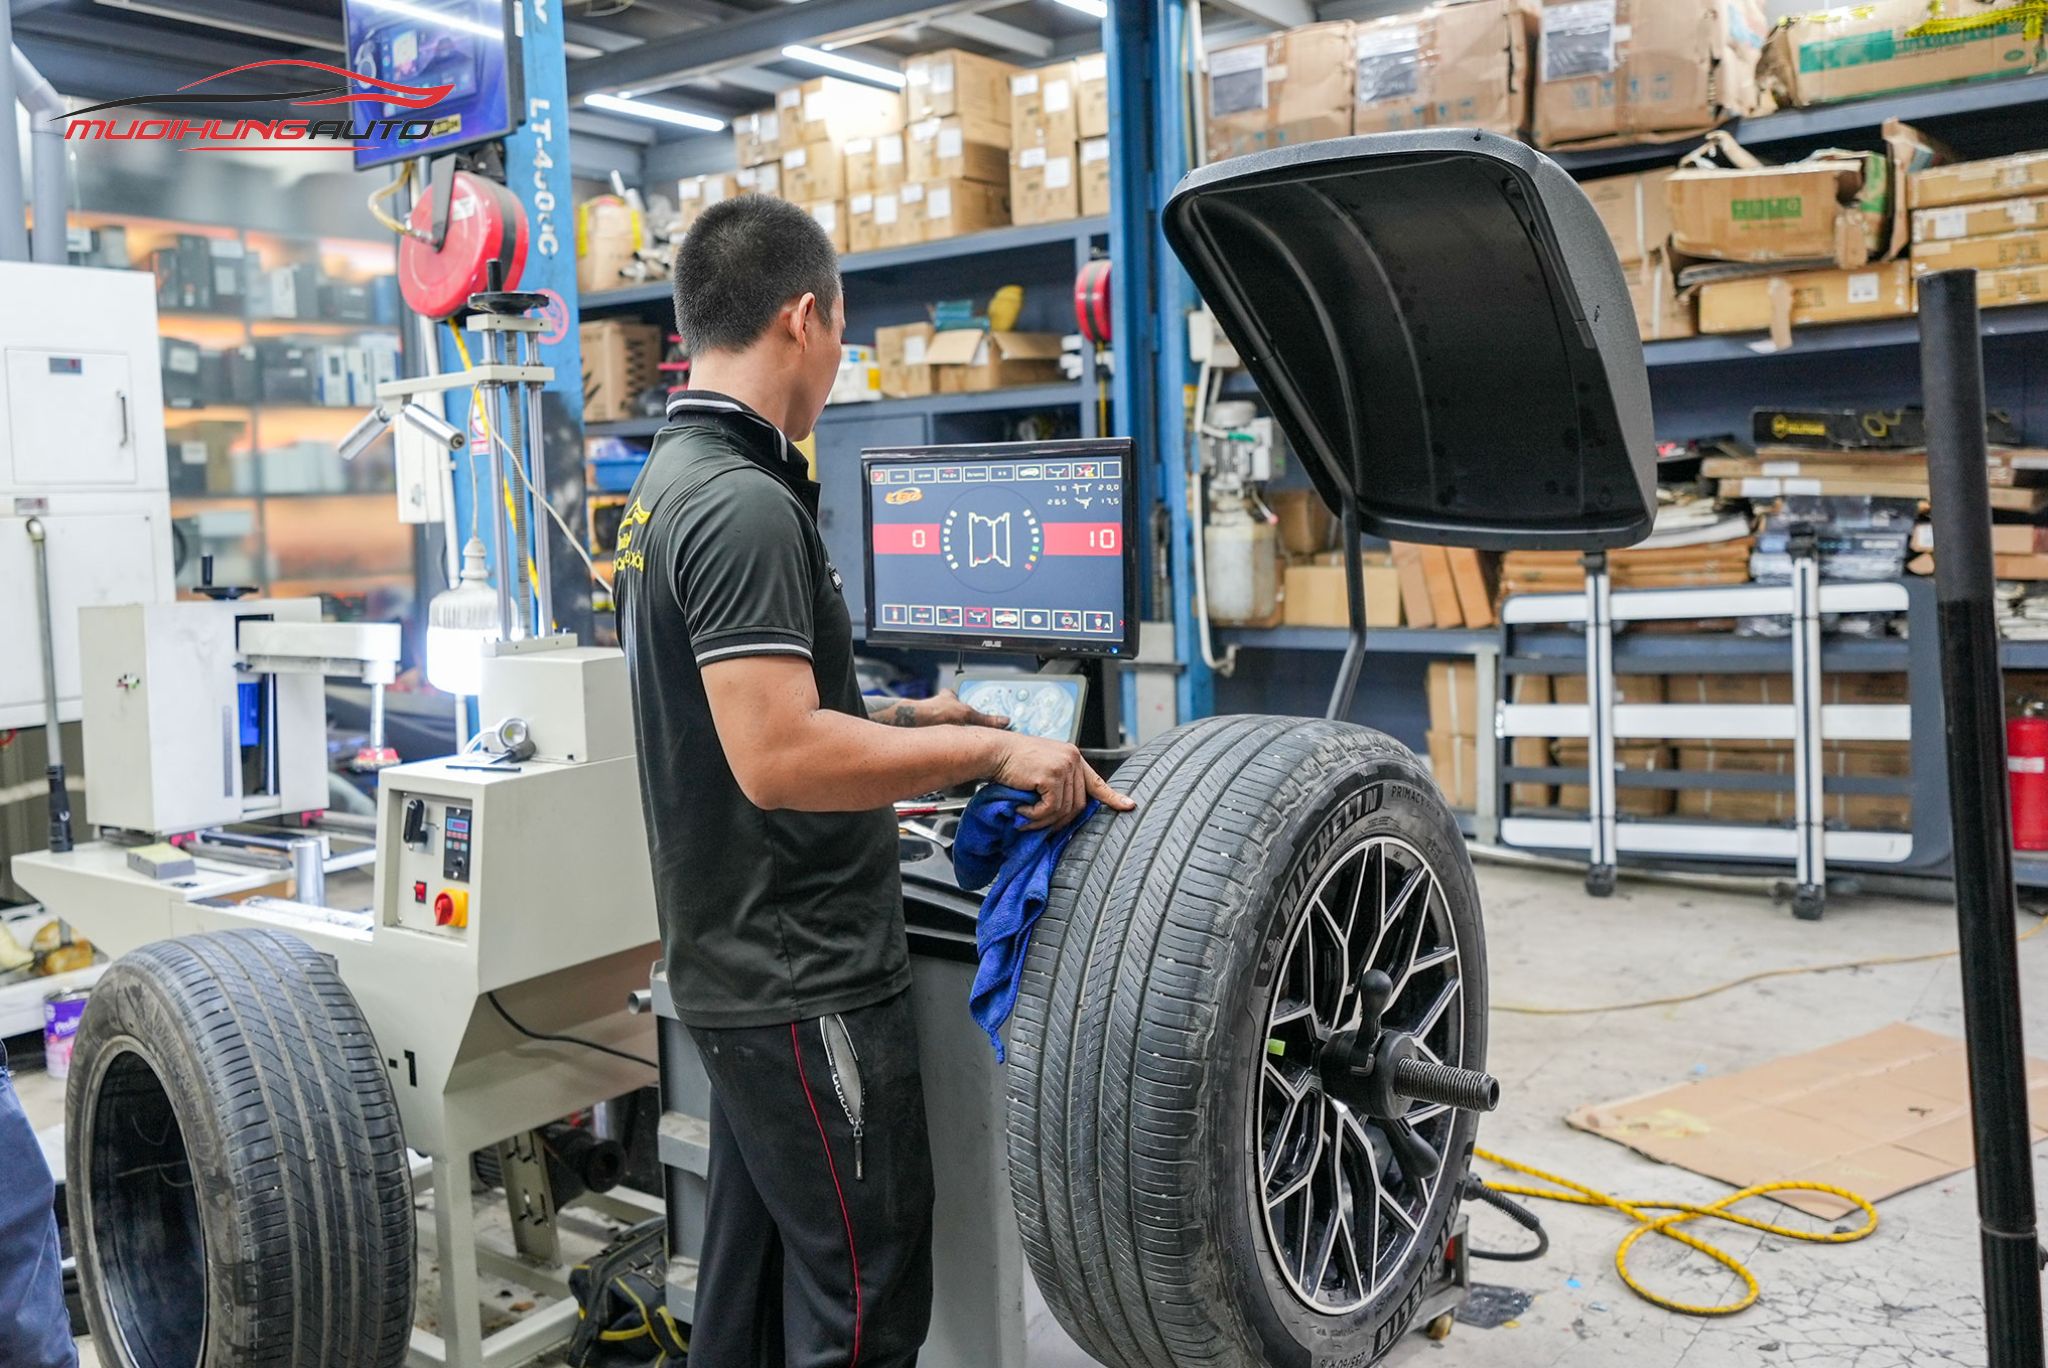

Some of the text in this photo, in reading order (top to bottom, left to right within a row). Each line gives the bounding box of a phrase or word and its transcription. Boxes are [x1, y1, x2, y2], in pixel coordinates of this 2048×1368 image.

[912, 529, 1116, 550] 0 10
[981, 640, 1003, 648] ASUS
[1391, 785, 1427, 807] PRIMACY
[1280, 785, 1380, 926] MICHELIN
